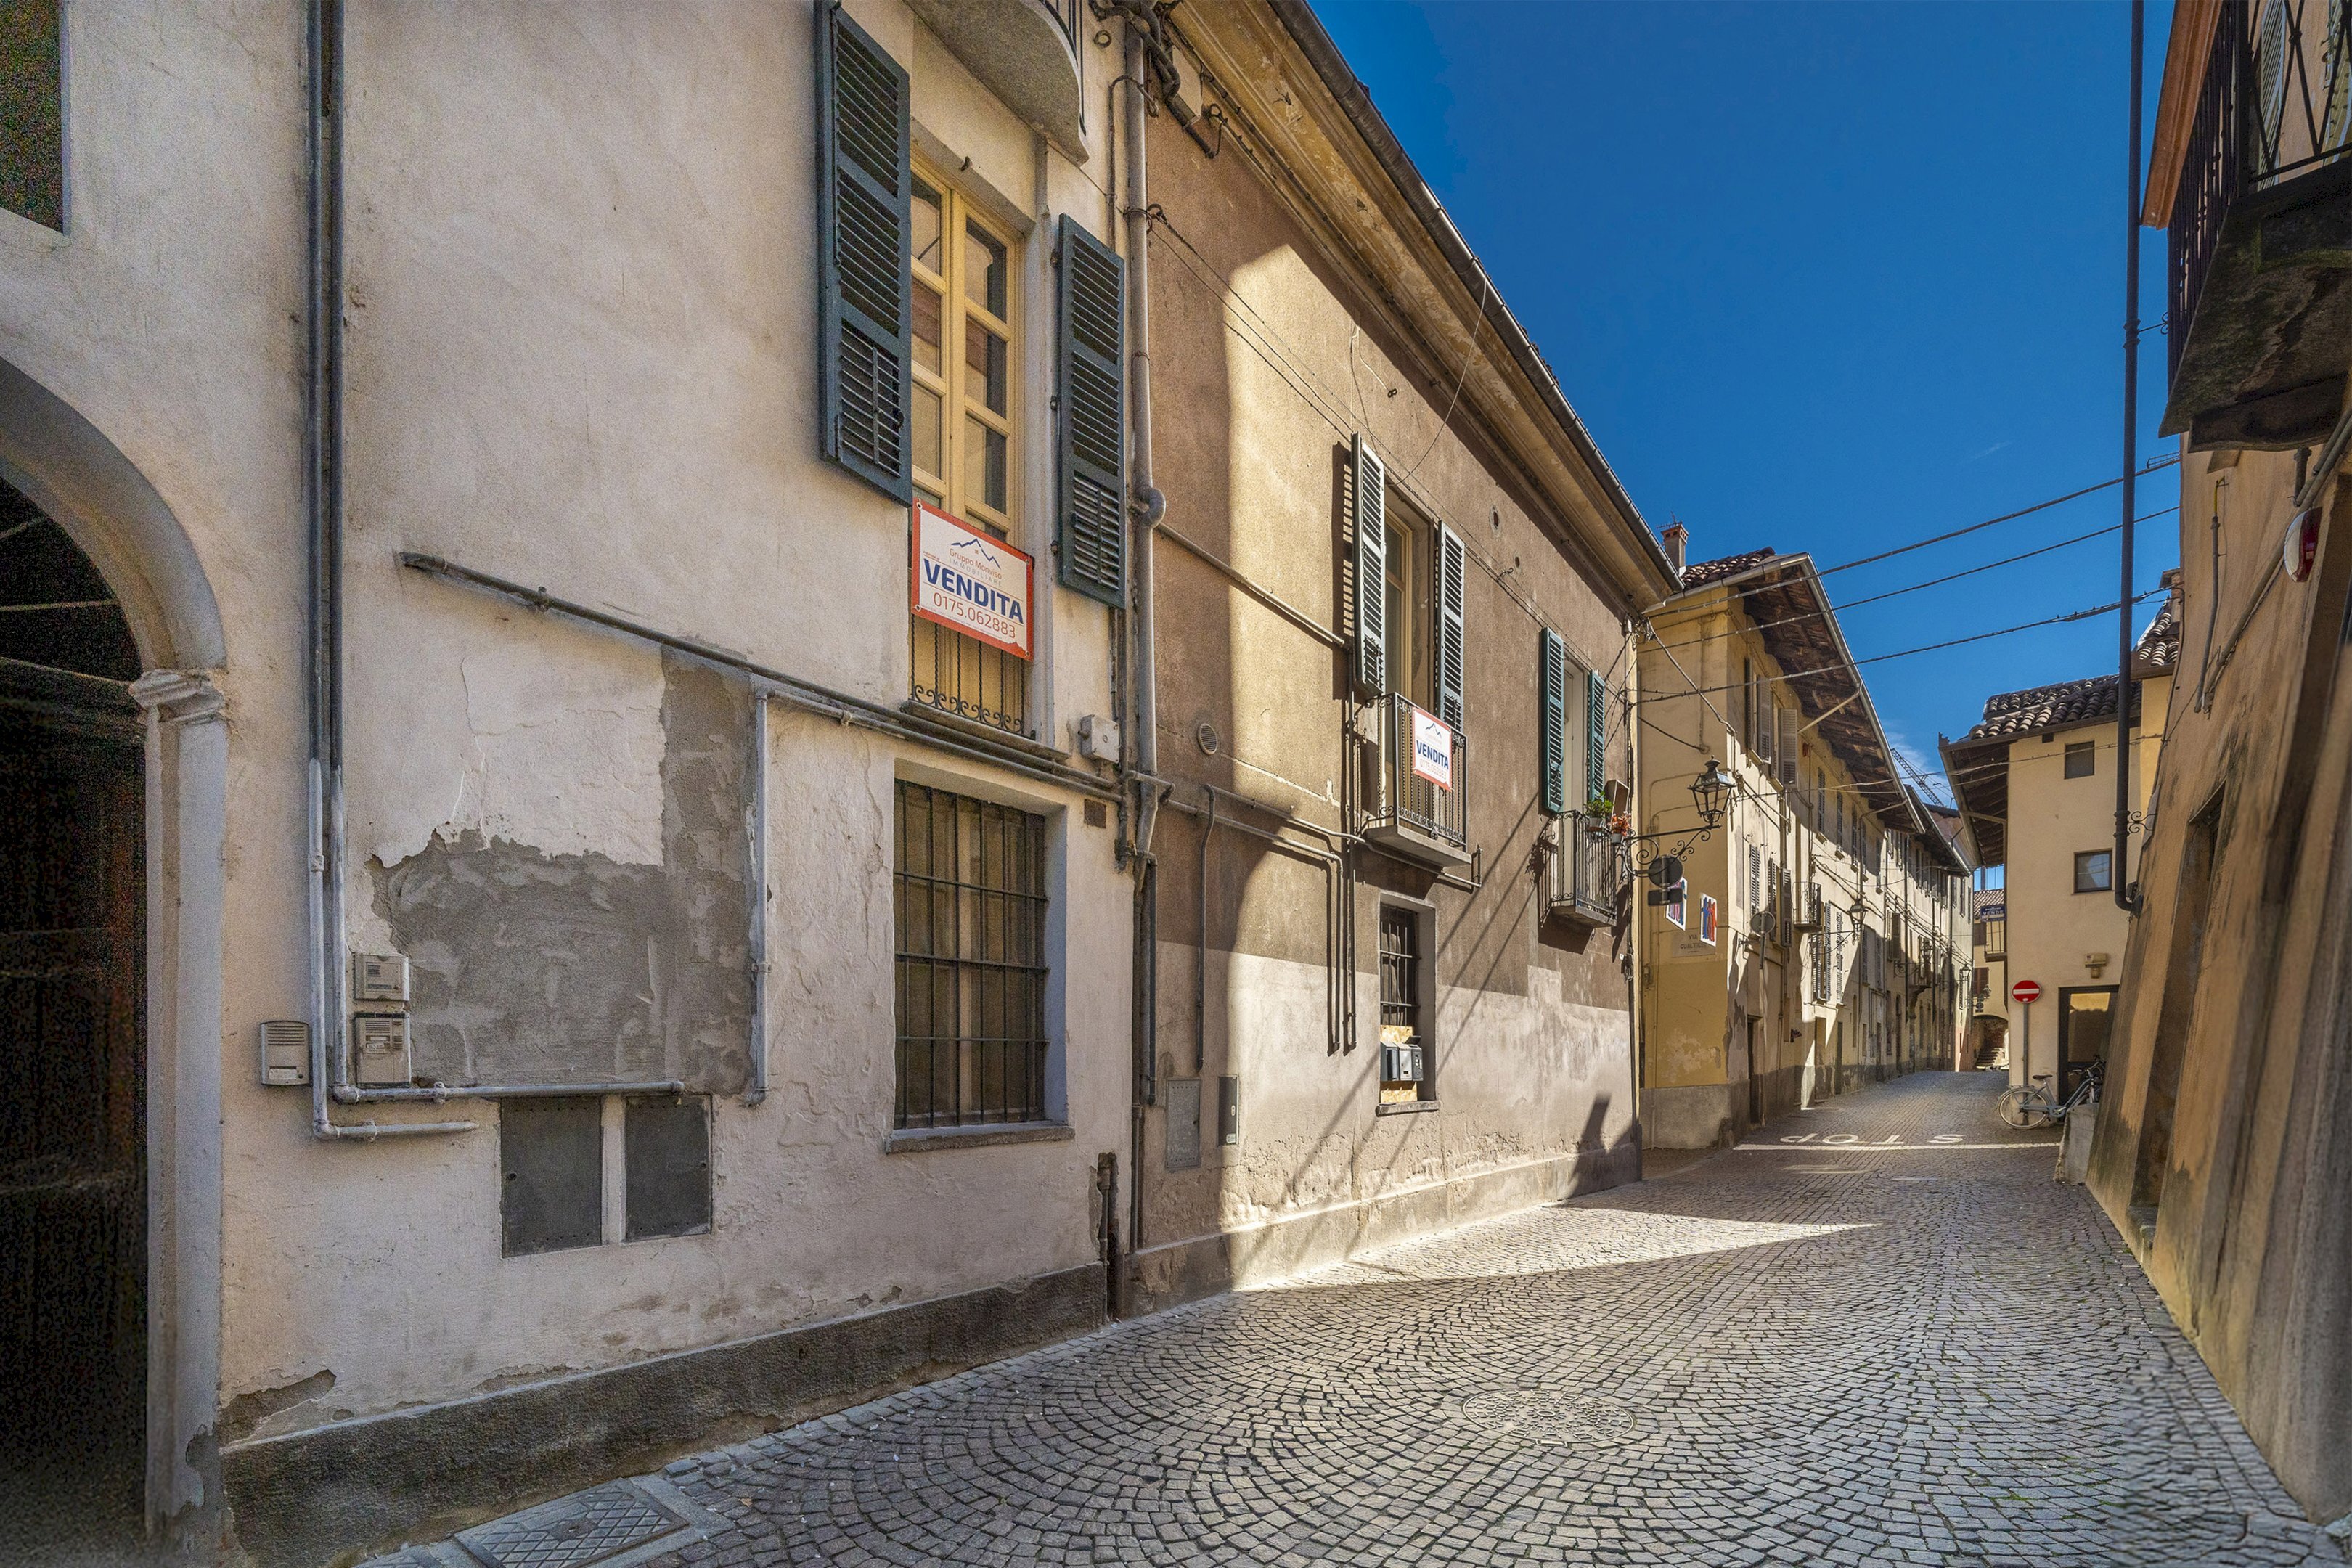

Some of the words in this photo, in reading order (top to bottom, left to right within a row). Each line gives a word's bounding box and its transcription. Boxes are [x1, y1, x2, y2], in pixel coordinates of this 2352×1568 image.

[949, 558, 1002, 587] IMMOBILIARE
[950, 548, 974, 566] Gruppo
[975, 560, 1002, 580] Monviso
[923, 558, 1024, 624] VENDITA
[934, 592, 1016, 639] 0175.062883
[1416, 740, 1449, 769] VENDITA
[1779, 1132, 1967, 1145] STOP
